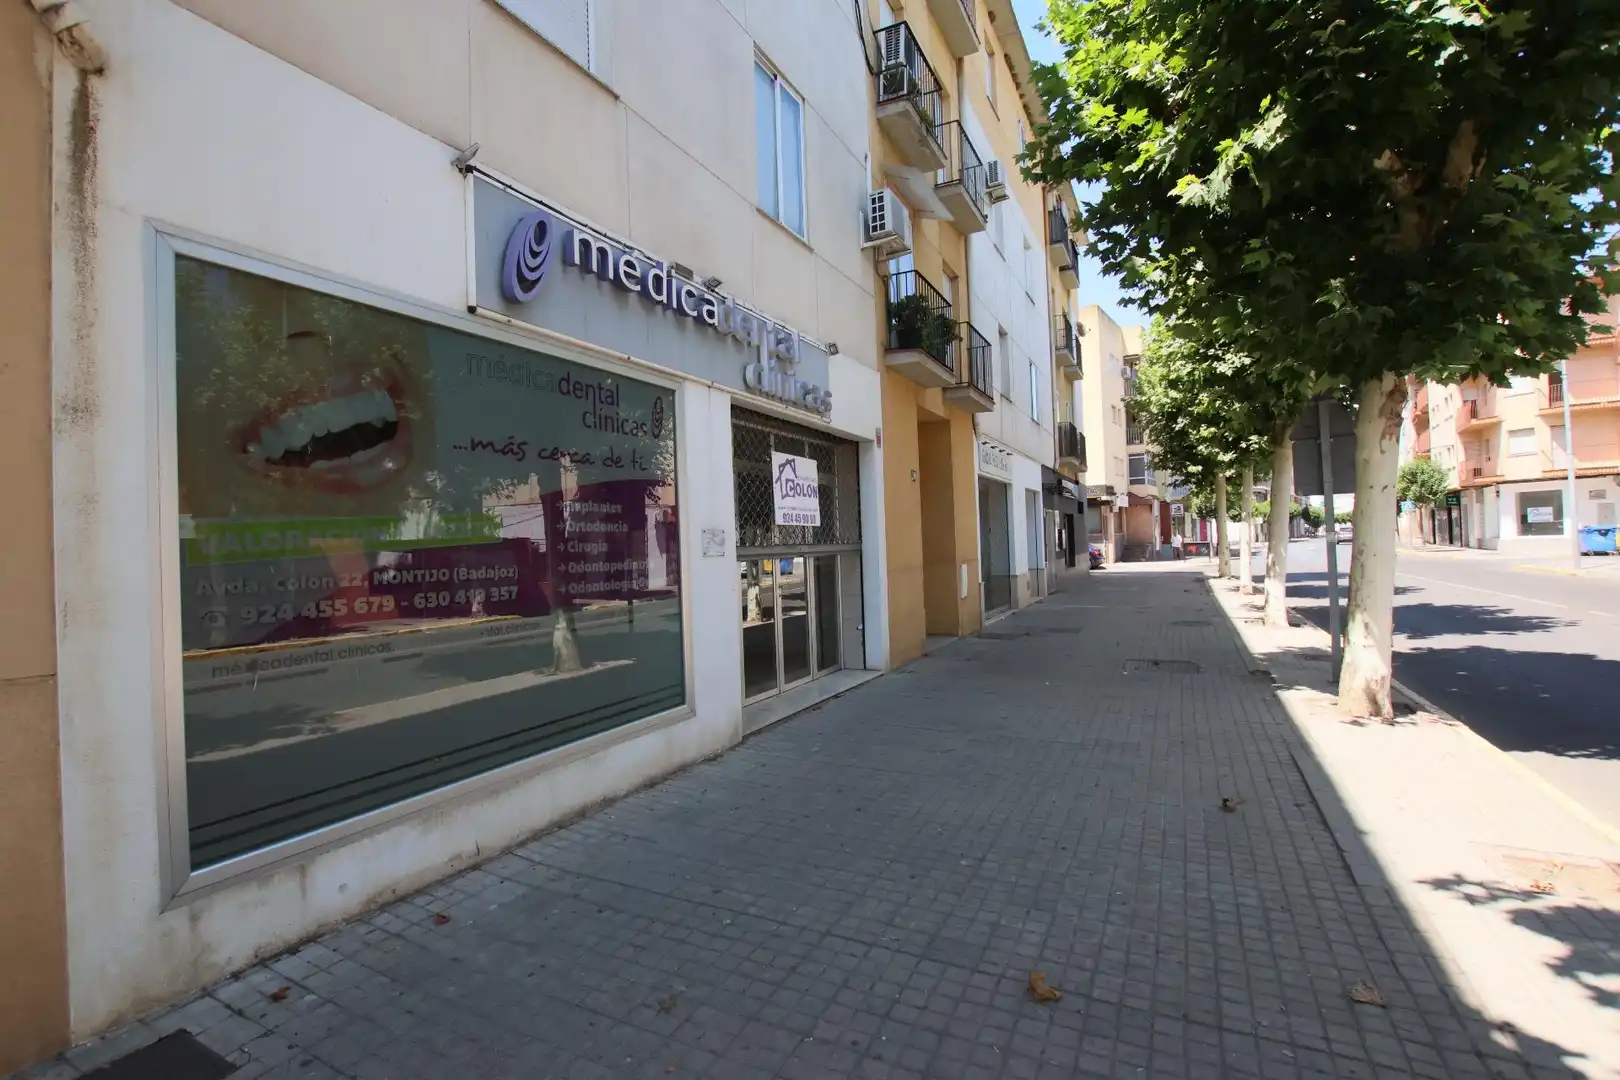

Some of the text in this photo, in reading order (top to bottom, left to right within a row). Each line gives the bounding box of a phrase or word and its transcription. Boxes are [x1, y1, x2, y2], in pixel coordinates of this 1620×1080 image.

[603, 446, 625, 469] de
[453, 565, 519, 584] (Badajoz)
[240, 602, 295, 625] 924
[301, 597, 348, 620] 455
[353, 594, 396, 615] 679
[413, 590, 451, 610] 630
[489, 585, 519, 603] 357
